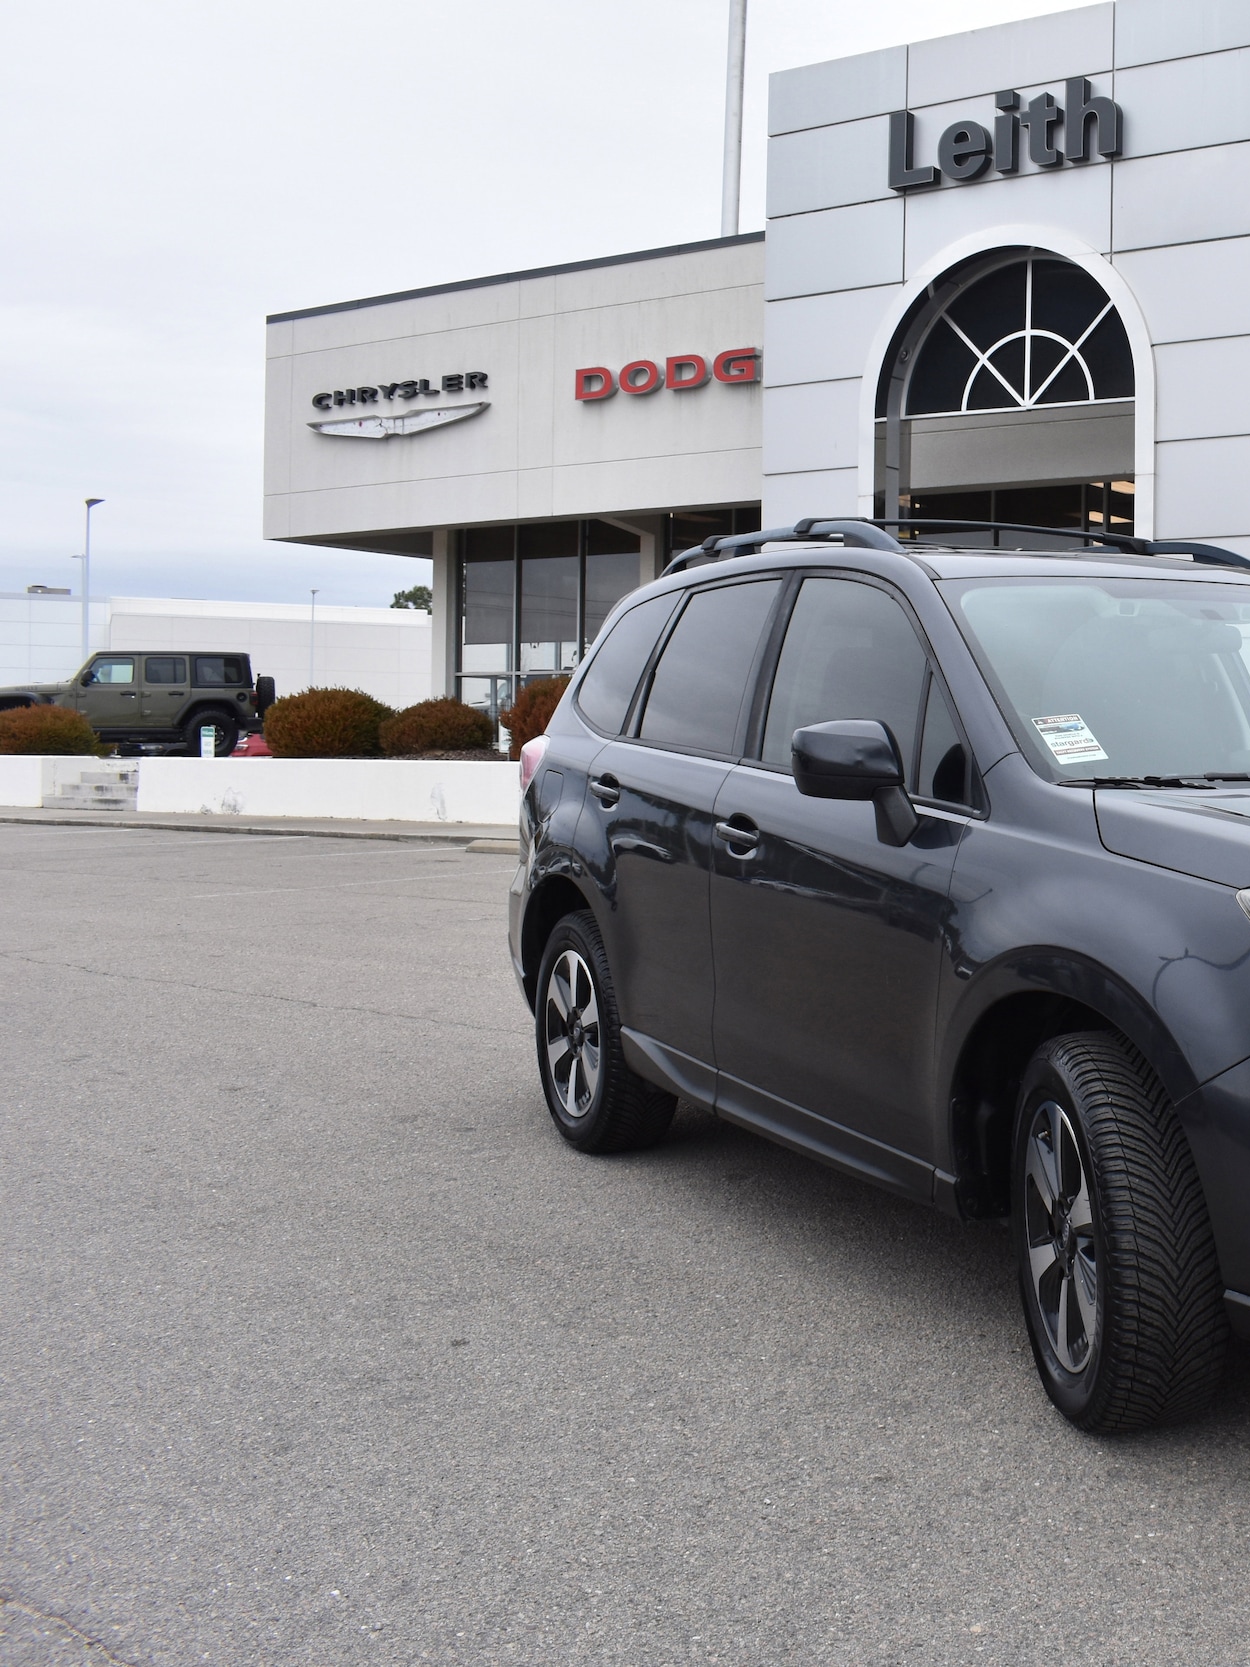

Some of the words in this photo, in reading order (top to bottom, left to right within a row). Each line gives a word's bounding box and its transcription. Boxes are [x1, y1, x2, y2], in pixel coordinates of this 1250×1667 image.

[888, 76, 1123, 191] Leith
[312, 371, 489, 409] CHRYSLER
[575, 347, 762, 402] DODG
